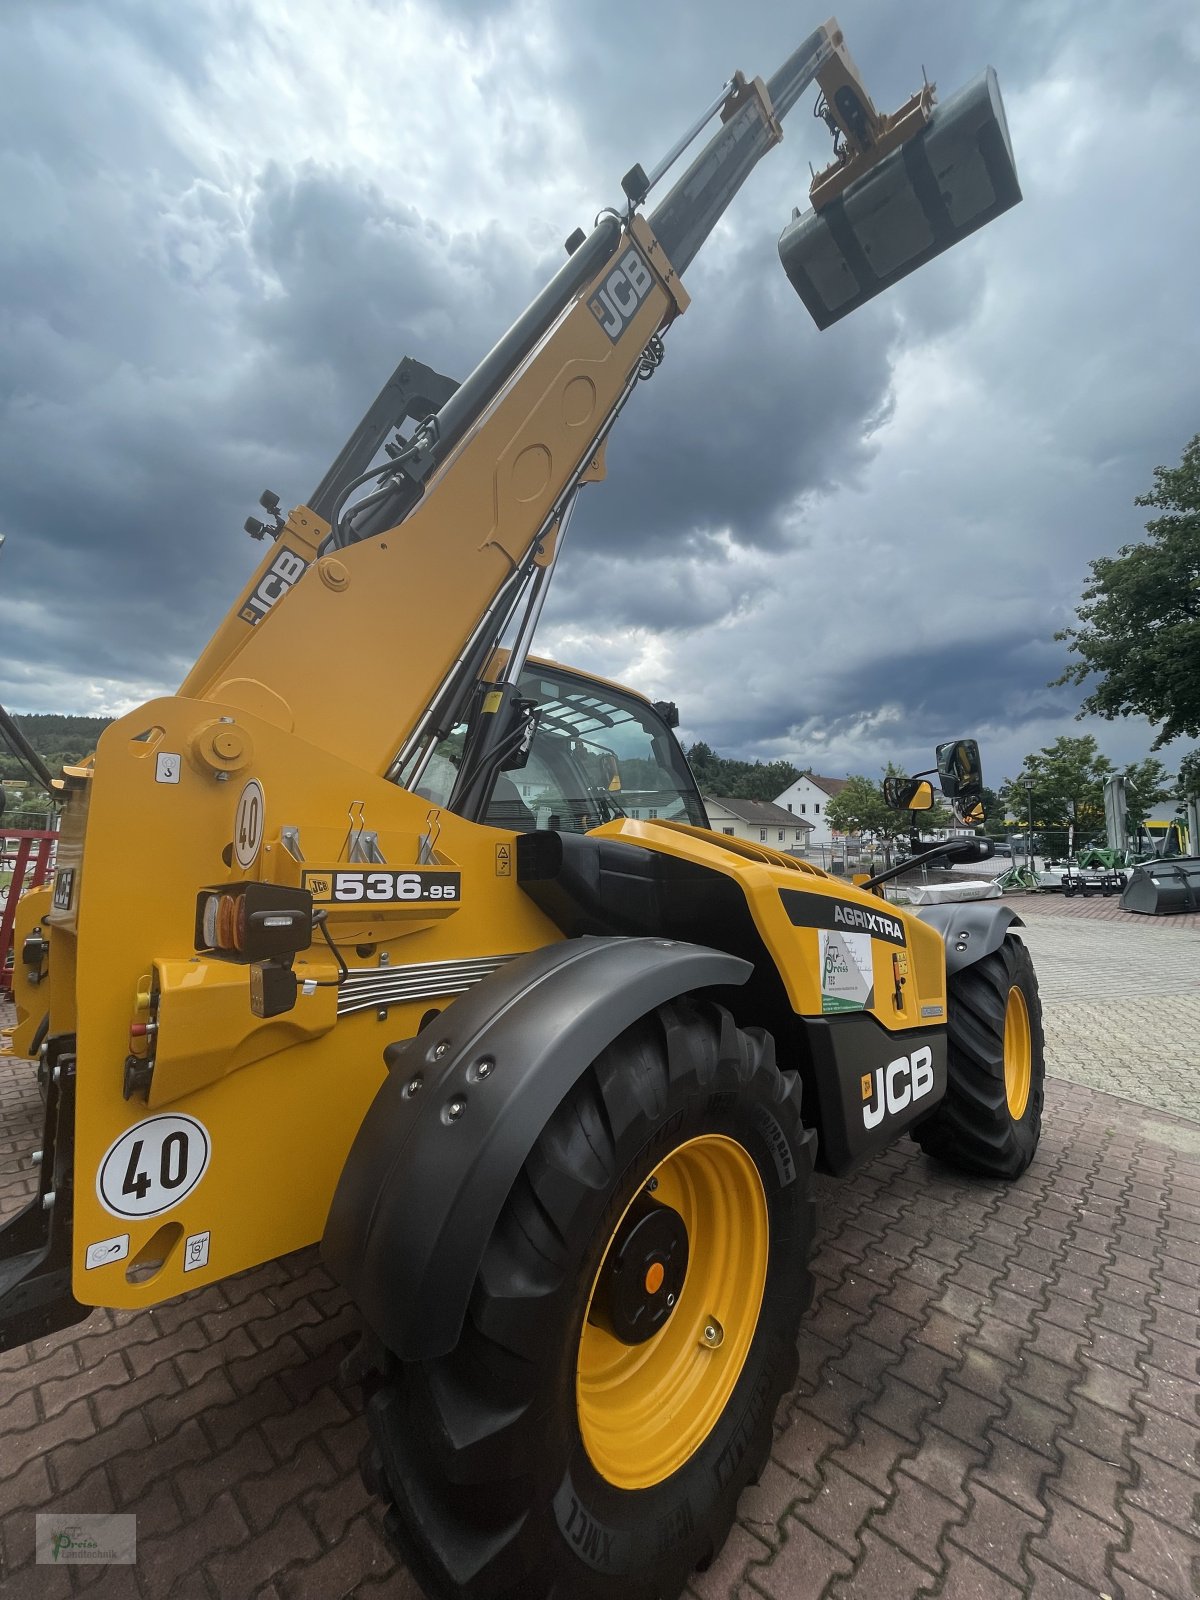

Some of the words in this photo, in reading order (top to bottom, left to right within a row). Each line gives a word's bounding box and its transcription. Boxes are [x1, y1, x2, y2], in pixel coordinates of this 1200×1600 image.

[599, 250, 652, 337] JCB
[250, 551, 305, 625] JCB
[239, 797, 258, 850] 40
[311, 879, 329, 896] JCB
[834, 905, 903, 940] AGRIXTRA
[863, 1045, 934, 1130] JCB
[122, 1131, 189, 1199] 40
